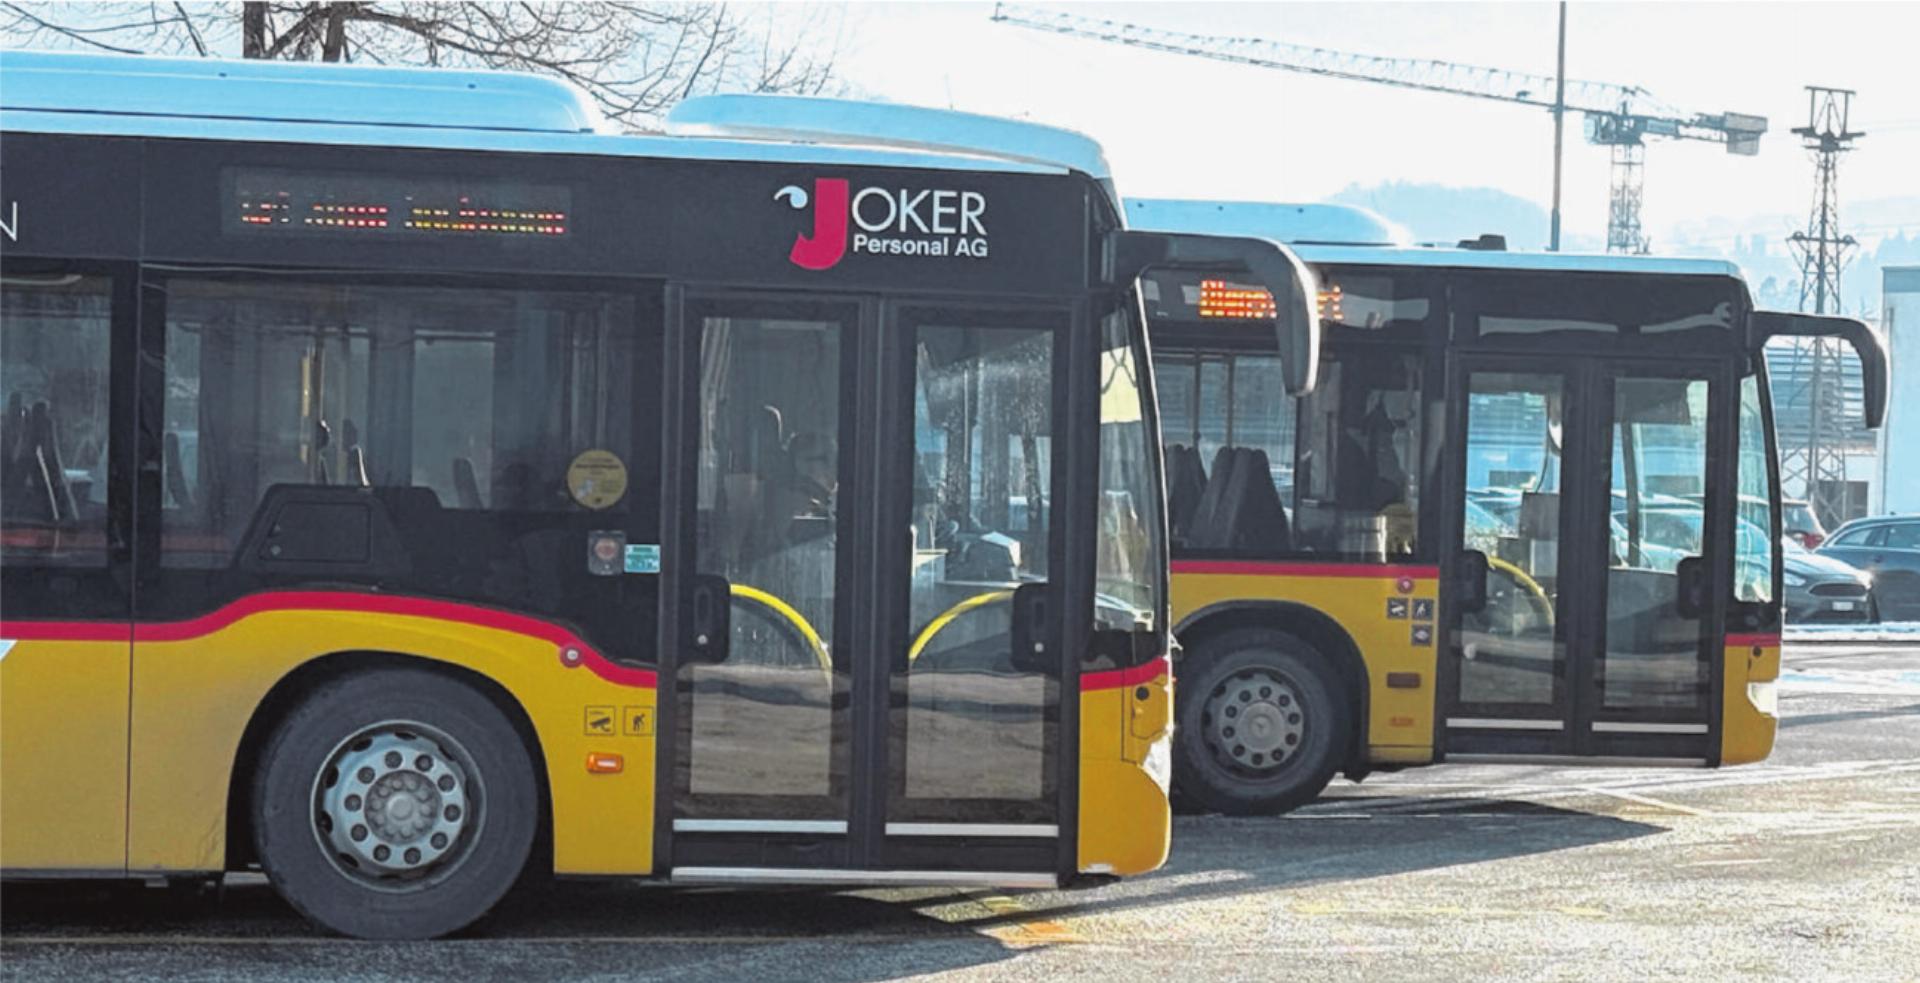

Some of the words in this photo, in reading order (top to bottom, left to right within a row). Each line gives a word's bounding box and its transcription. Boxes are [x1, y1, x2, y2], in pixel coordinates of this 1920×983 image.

[789, 178, 987, 270] JOKER
[853, 233, 949, 256] Personal
[954, 237, 988, 257] AG
